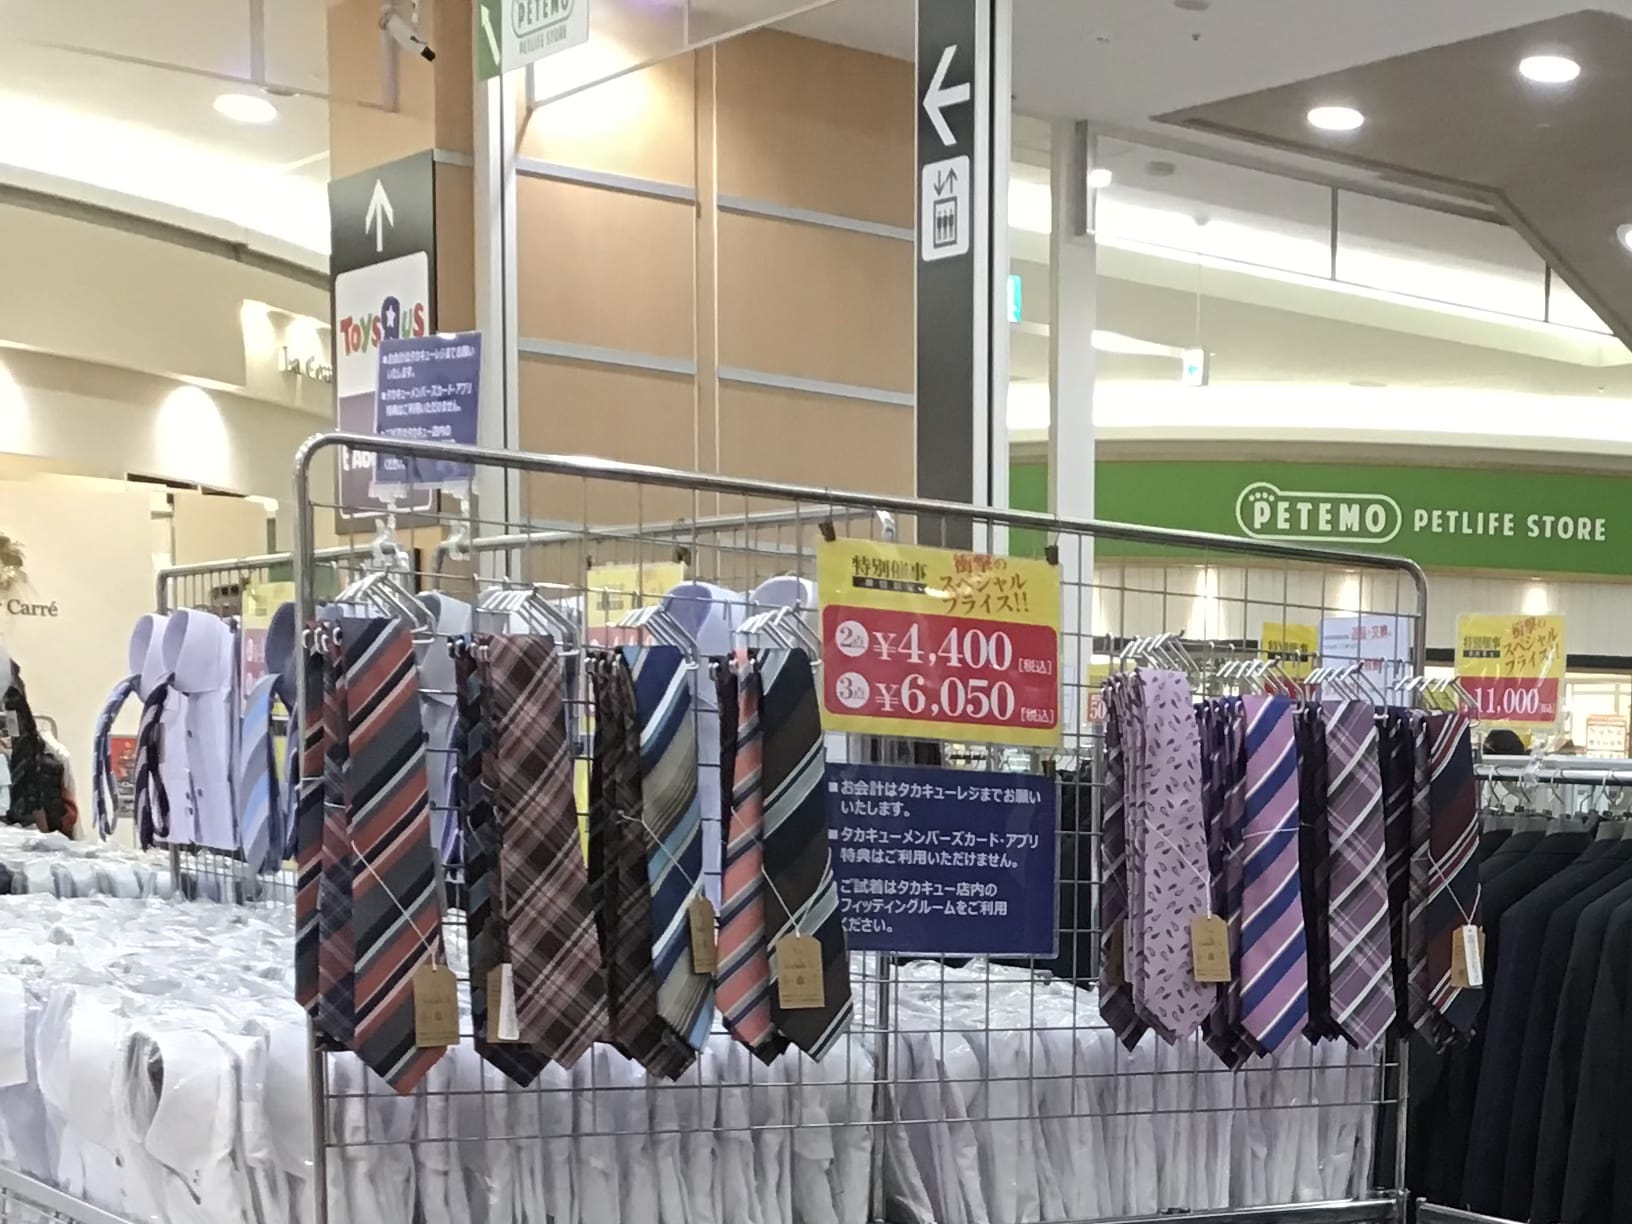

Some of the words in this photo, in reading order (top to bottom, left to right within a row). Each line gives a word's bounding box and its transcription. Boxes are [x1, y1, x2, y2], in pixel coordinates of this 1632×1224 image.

[1253, 502, 1387, 534] PETEMO
[1412, 508, 1515, 537] PETLIFE
[1526, 514, 1607, 542] STORE
[6, 598, 59, 617] Carré
[873, 623, 1013, 671] ¥4,400
[875, 673, 1015, 721] ¥6,050
[840, 780, 1042, 805] お会計はタカキューレジまでお願い
[840, 800, 911, 818] いたします。
[840, 848, 1019, 869] 特典はご利用いただけません。
[840, 878, 999, 898] ご試着はタカキュー店内の
[840, 898, 1008, 917] フィッティングルームをご利用
[840, 916, 894, 934] ください。
